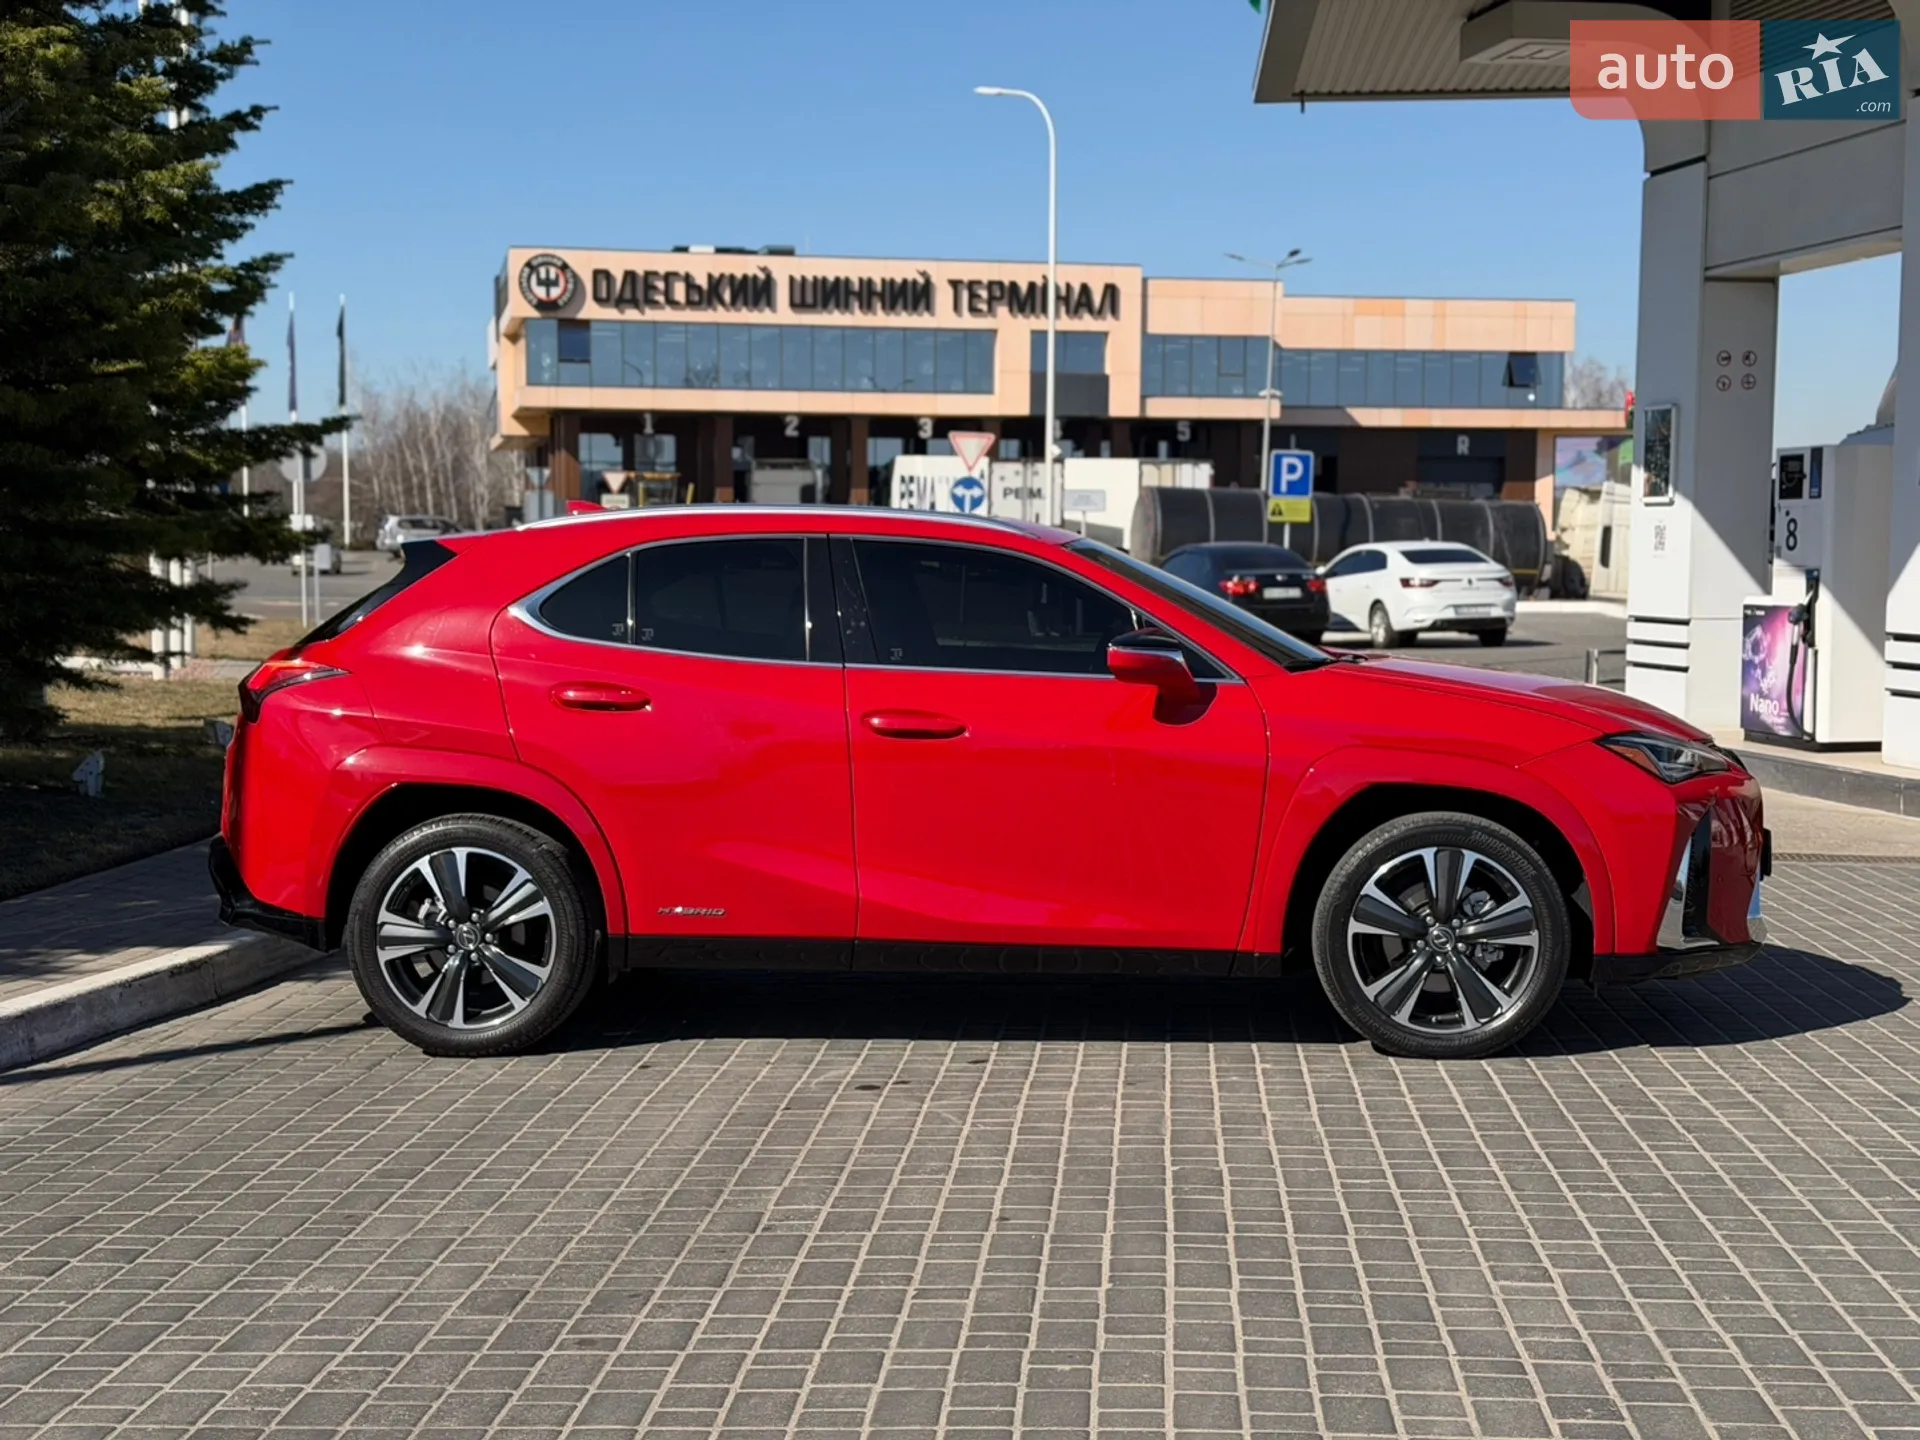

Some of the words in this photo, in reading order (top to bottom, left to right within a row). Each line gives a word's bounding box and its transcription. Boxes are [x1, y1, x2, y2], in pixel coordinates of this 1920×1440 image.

[592, 265, 775, 314] ОДЕСЬКИЙ
[788, 269, 935, 314] ШИННИЙ
[947, 274, 1119, 321] ТЕРМІНАЛ
[642, 412, 654, 434] 1
[784, 415, 799, 437] 2
[917, 418, 933, 439] 3
[1457, 434, 1470, 456] R
[1279, 456, 1304, 494] P
[1785, 517, 1798, 552] 8
[1750, 692, 1780, 716] Nano
